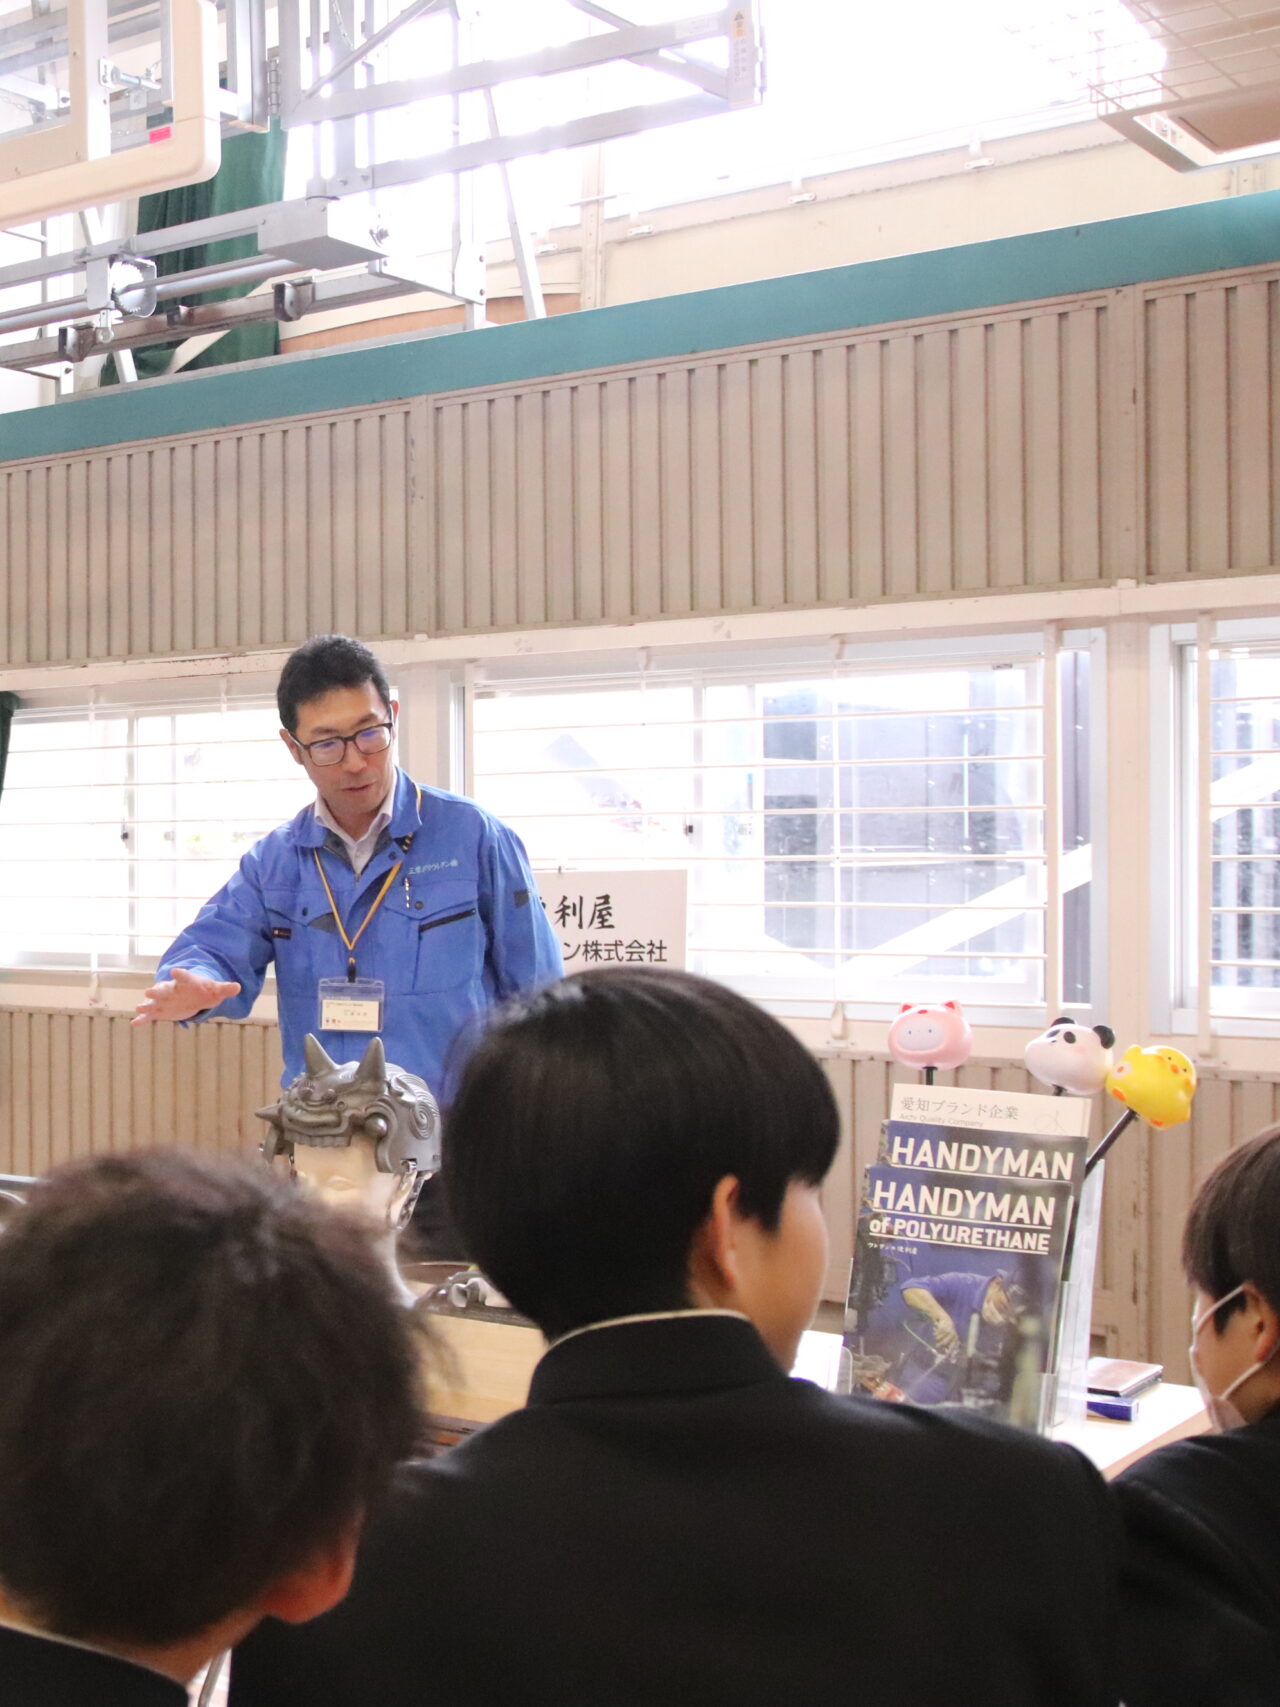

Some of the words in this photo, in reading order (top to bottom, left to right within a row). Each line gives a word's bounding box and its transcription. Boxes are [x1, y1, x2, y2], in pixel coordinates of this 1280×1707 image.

[540, 894, 615, 930] 利屋
[563, 939, 668, 963] ン株式会社
[900, 1096, 1020, 1121] 愛知ブランド企業
[891, 1135, 1075, 1180] HANDYMAN
[873, 1179, 1056, 1227] HANDYMAN
[869, 1217, 892, 1234] of
[893, 1218, 1052, 1252] POLYURETHANE
